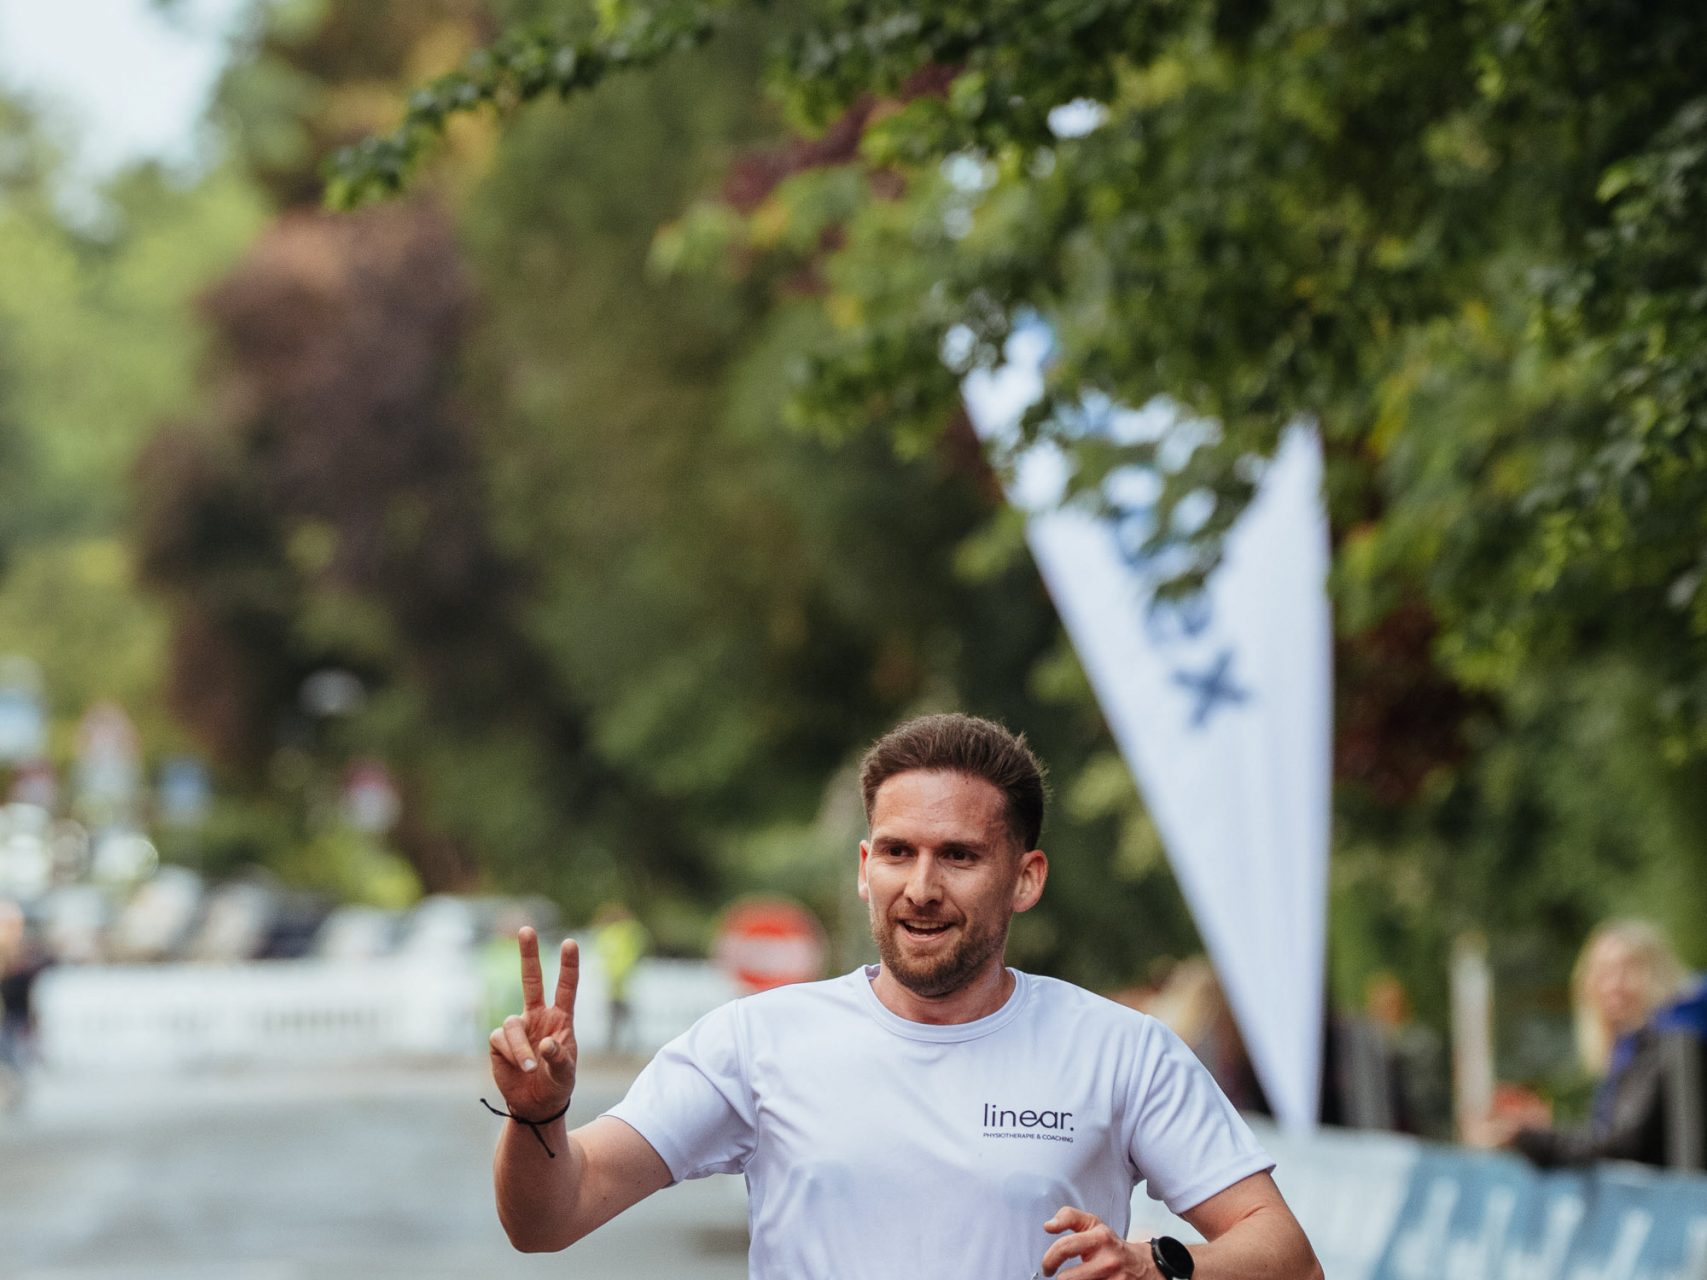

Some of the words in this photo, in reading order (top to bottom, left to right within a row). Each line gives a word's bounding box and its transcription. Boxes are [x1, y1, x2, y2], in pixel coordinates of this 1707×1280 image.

[983, 1103, 1074, 1131] linear.
[983, 1132, 1034, 1140] PHYSIOTHERAPIE
[1042, 1134, 1074, 1143] COACHING
